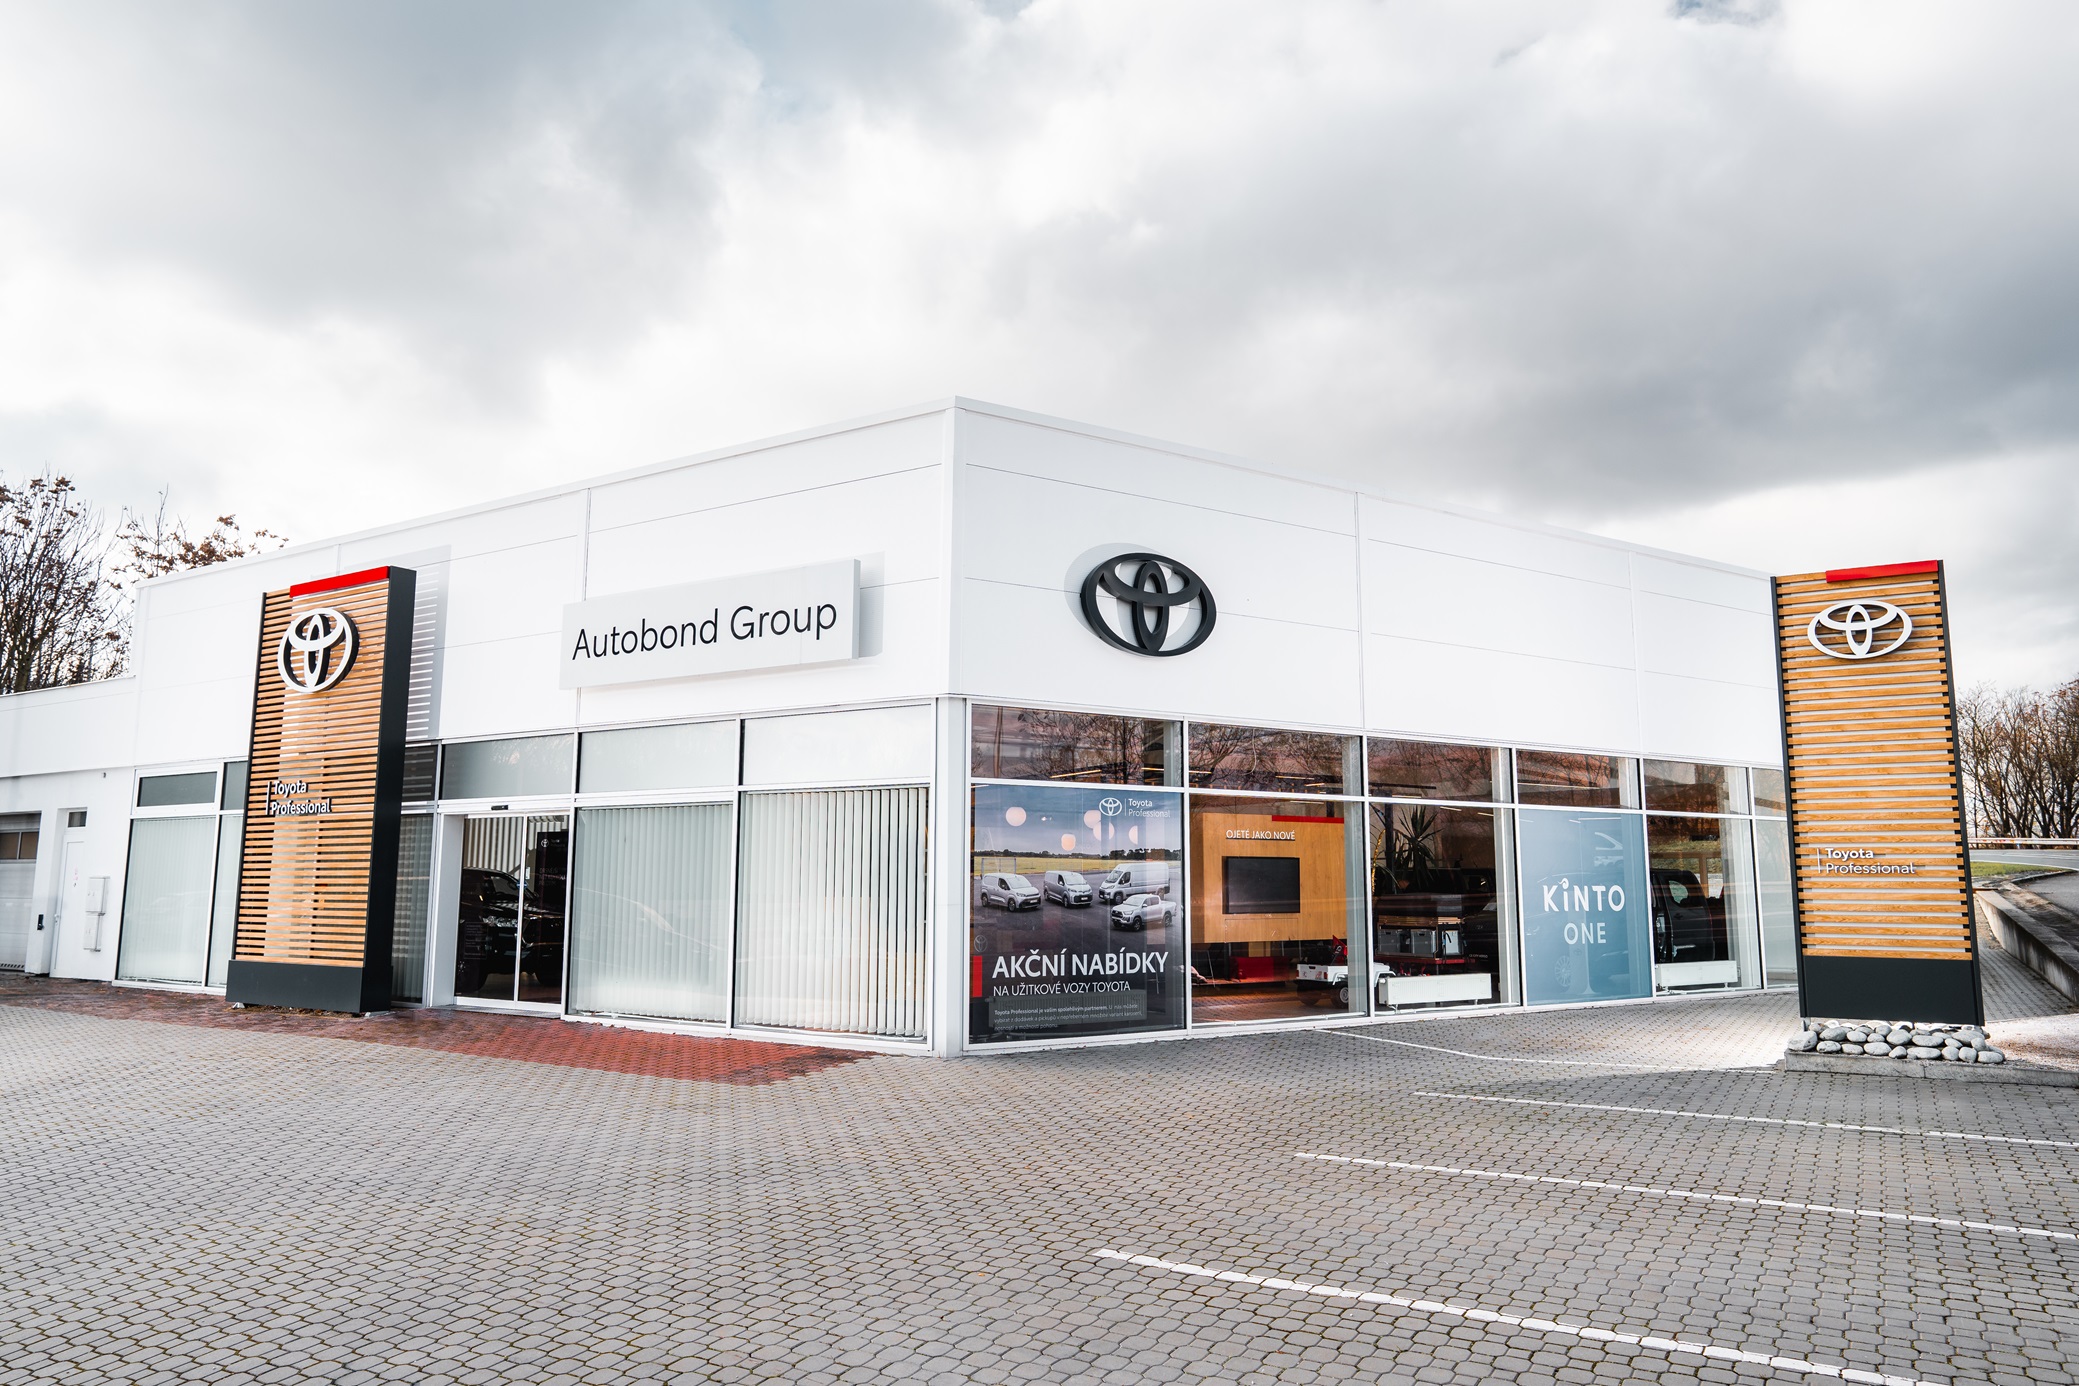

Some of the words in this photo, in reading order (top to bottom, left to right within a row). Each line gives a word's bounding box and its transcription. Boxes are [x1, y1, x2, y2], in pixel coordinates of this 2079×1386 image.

[572, 608, 718, 660] Autobond
[730, 603, 837, 640] Group
[274, 780, 308, 798] Toyota
[271, 798, 331, 815] Professional
[1128, 798, 1153, 808] Toyota
[1128, 808, 1171, 818] Professional
[1226, 829, 1250, 839] OJETÉ
[1251, 830, 1272, 840] JAKO
[1273, 830, 1296, 840] NOVÉ
[1825, 847, 1875, 862] Toyota
[1826, 862, 1916, 874] Professional
[1563, 922, 1607, 945] ONE
[991, 948, 1067, 979] AKČNÍ
[1071, 947, 1169, 976] NABÍDKY
[993, 985, 1009, 997] NA
[1011, 981, 1061, 996] UŽITKOVÉ
[1063, 982, 1091, 994] VOZY
[1092, 981, 1131, 992] TOYOTA
[1010, 1007, 1039, 1015] Professional
